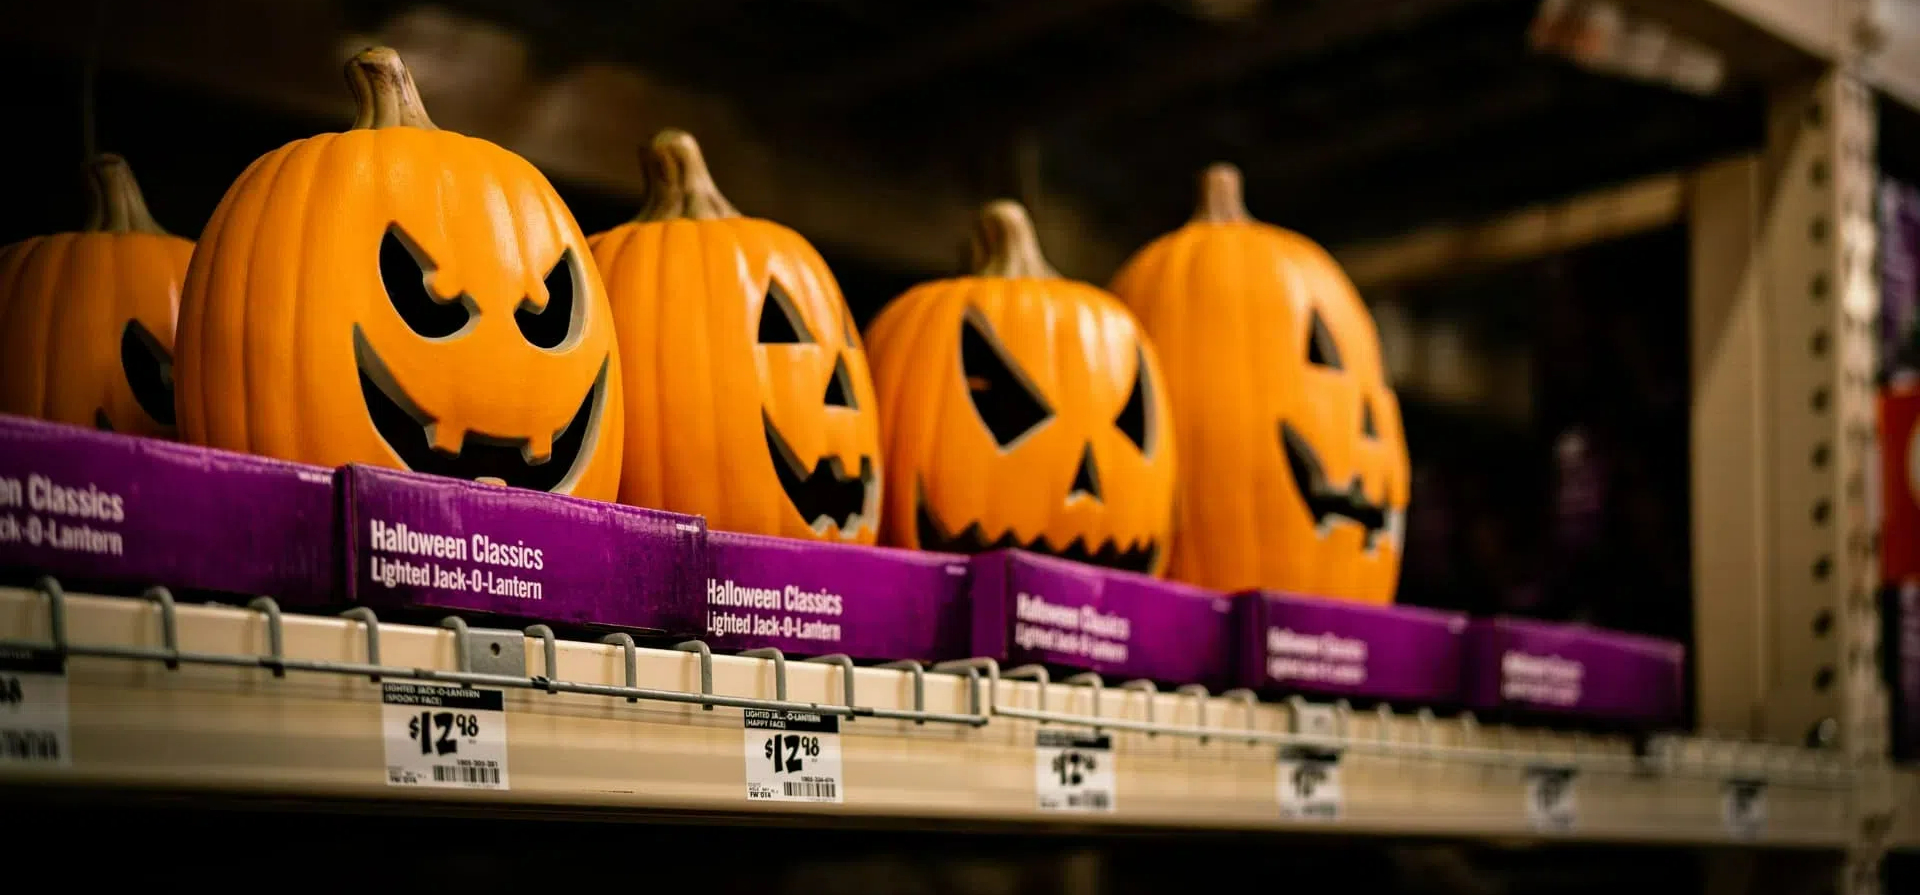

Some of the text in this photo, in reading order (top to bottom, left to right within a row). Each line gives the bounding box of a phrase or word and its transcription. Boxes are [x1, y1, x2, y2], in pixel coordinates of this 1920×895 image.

[28, 473, 124, 522] Classics
[370, 519, 544, 571] Halloween Classics
[371, 557, 542, 600] Lighted Jack-O-Lantern
[707, 578, 843, 616] Halloween Classics
[707, 610, 841, 642] Lighted Jack-O-Lantern
[745, 710, 770, 719] LIGHTED
